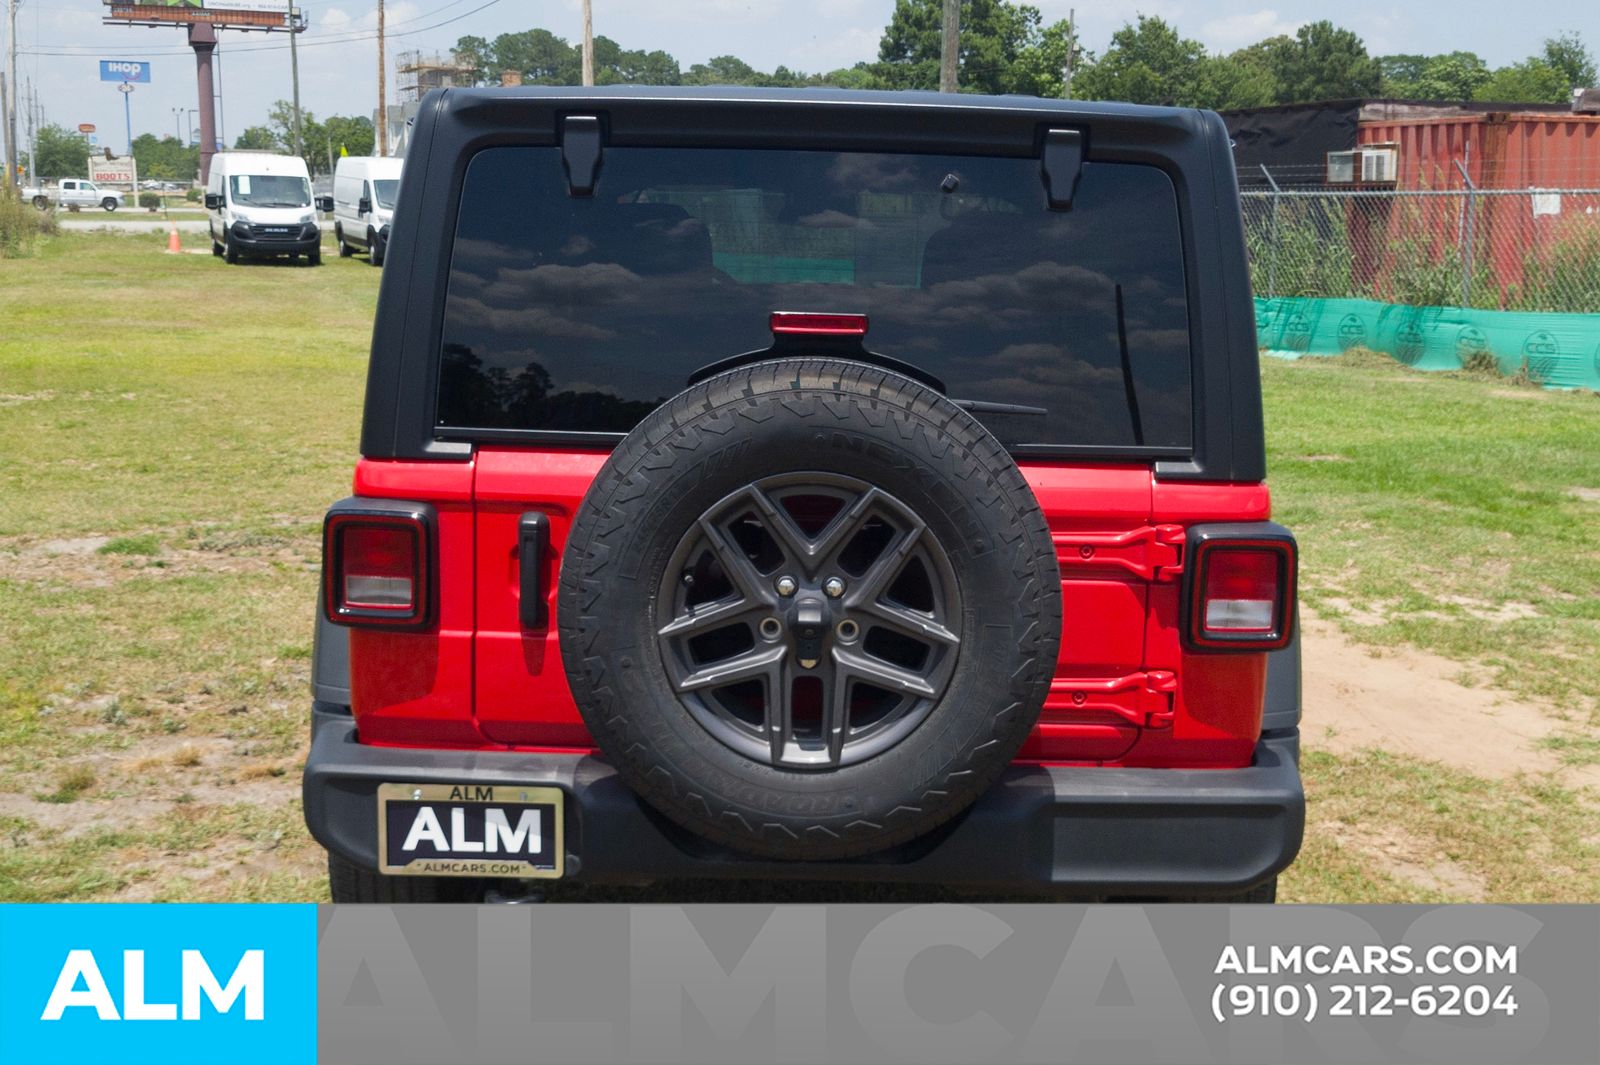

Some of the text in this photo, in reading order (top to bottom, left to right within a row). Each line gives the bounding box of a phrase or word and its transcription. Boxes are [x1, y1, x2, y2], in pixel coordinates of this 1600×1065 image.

[96, 173, 130, 181] BOOTS
[1340, 325, 1364, 335] CCS
[1525, 343, 1556, 354] CCS
[450, 786, 493, 801] ALM
[402, 806, 541, 853] ALM
[424, 863, 521, 874] ALMCARS.COM
